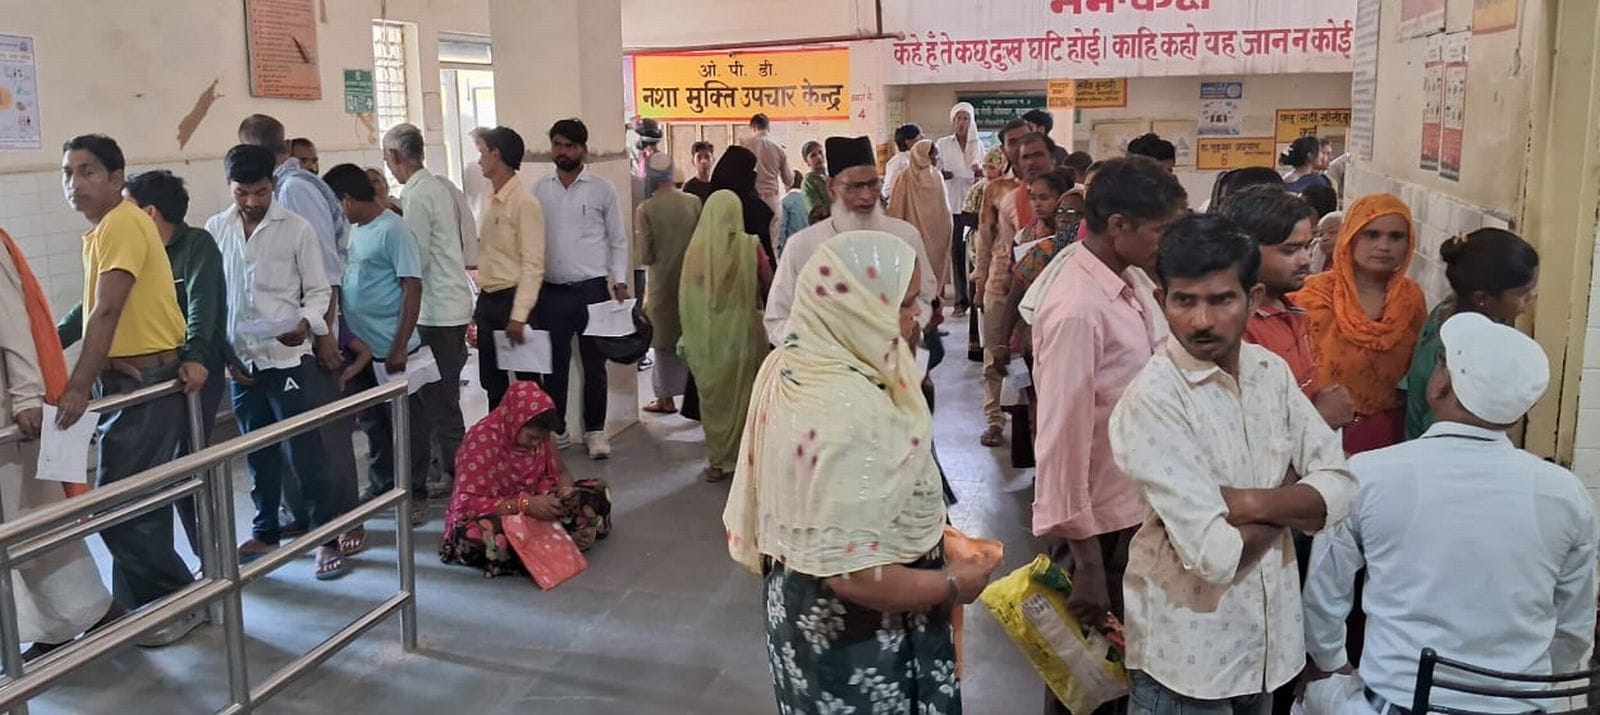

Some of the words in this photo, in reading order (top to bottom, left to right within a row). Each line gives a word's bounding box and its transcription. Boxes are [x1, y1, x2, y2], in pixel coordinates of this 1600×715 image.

[893, 33, 923, 67] कहे
[956, 39, 992, 69] कछु
[1026, 30, 1064, 61] घटि
[1112, 26, 1159, 60] काहि
[1160, 23, 1200, 60] कहो
[1203, 30, 1237, 60] यह
[1239, 28, 1292, 57] जान
[1293, 28, 1310, 53] न
[1311, 18, 1354, 60] कोई
[642, 86, 678, 108] नशा
[685, 80, 738, 113] मुक्ति
[740, 84, 797, 108] उपचार
[801, 78, 844, 111] केन्द्र
[857, 107, 867, 119] 4
